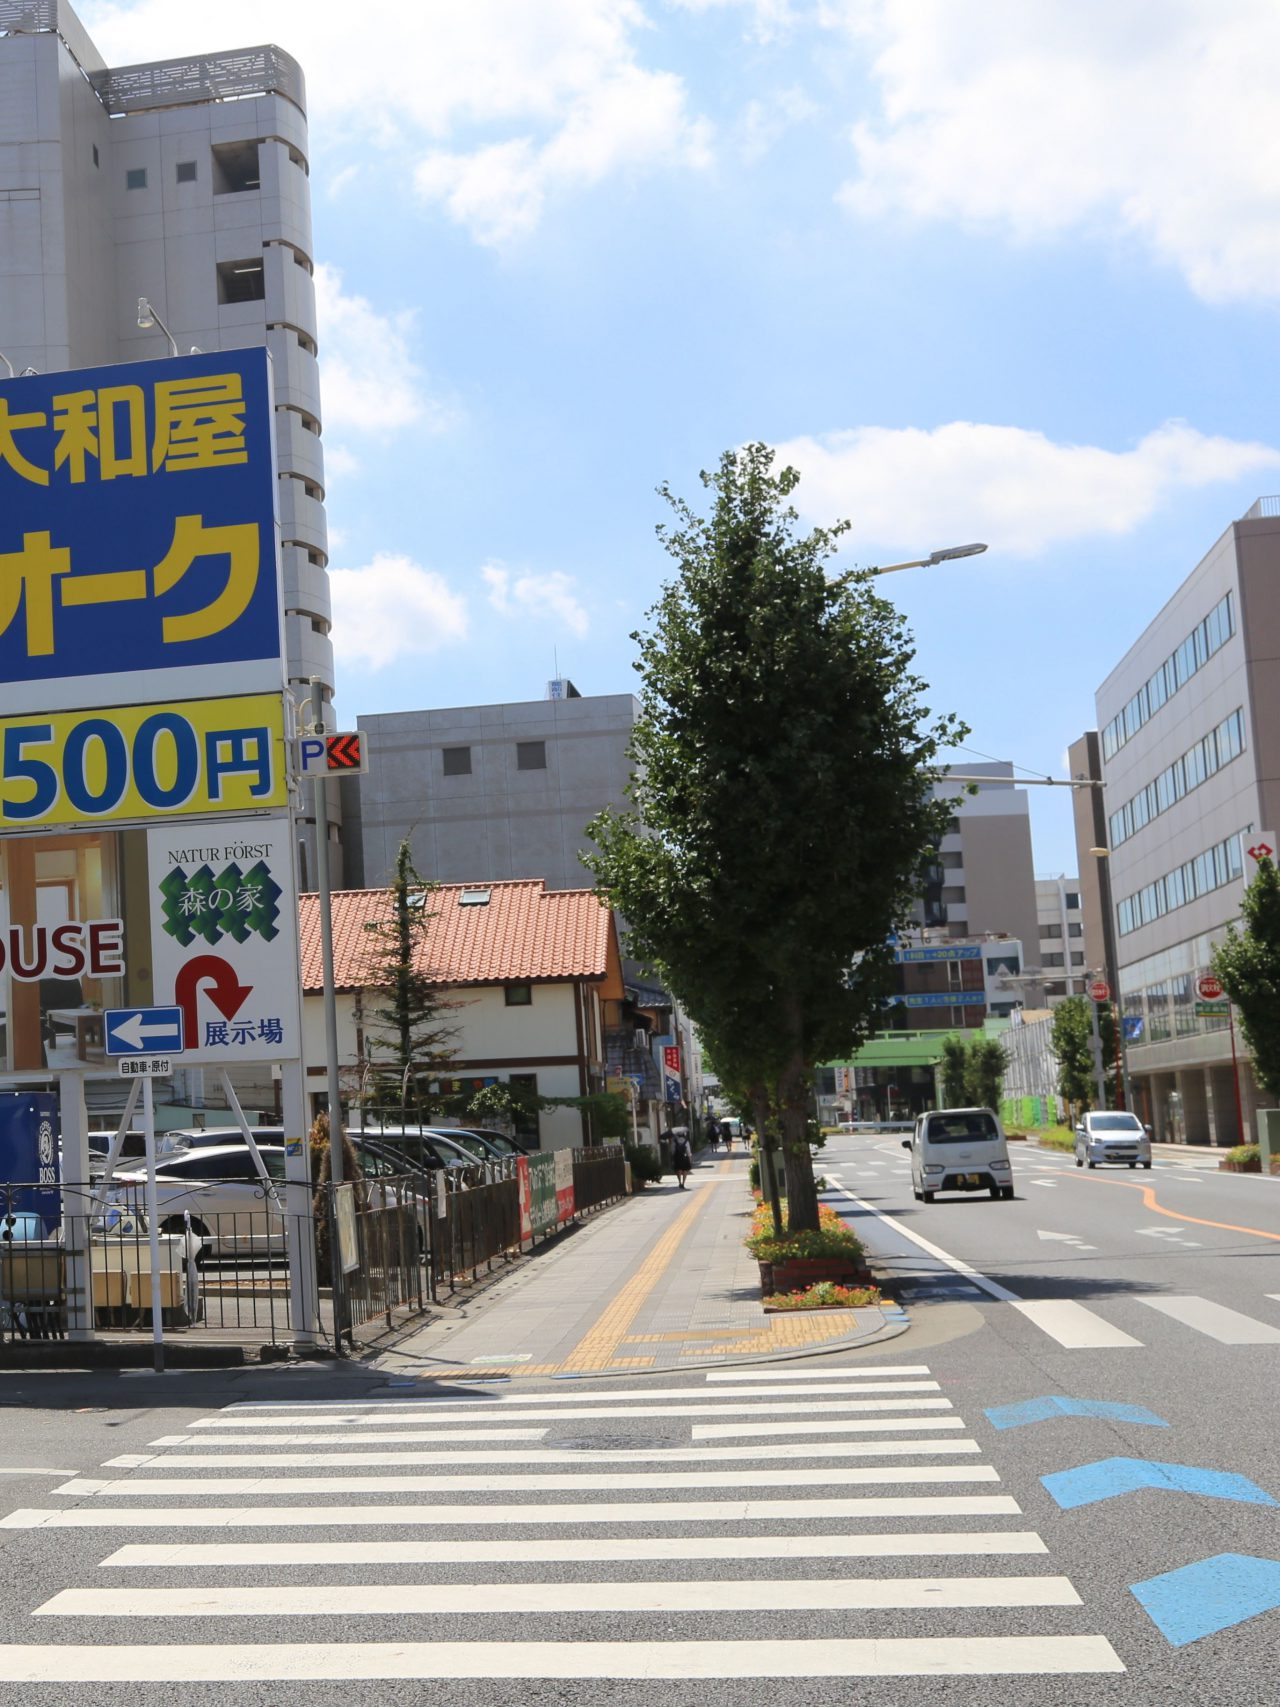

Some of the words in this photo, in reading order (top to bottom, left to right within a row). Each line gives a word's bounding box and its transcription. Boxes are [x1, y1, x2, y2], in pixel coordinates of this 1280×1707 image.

[301, 740, 324, 770] P
[168, 848, 220, 864] NATUR
[224, 840, 273, 861] FÖRST
[178, 884, 265, 916] 森の家
[204, 1018, 284, 1047] 展示場
[39, 1167, 56, 1184] BOSS
